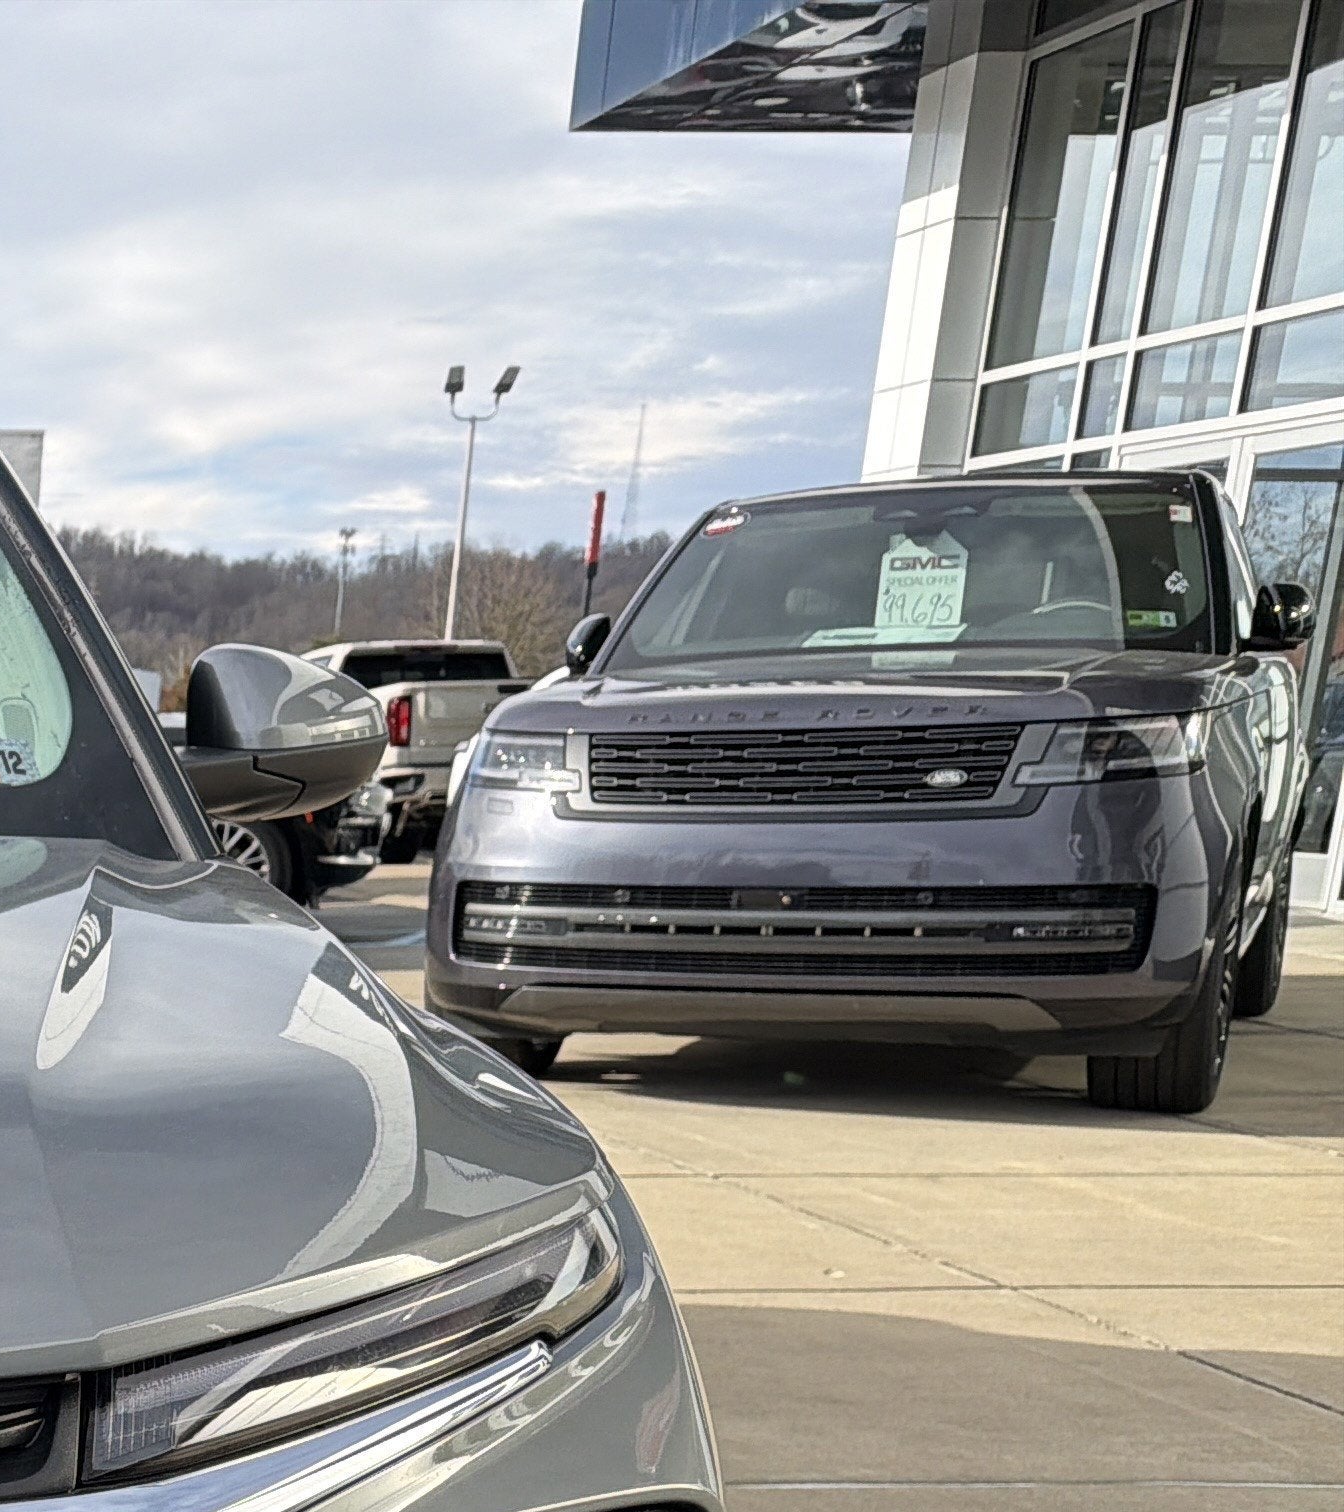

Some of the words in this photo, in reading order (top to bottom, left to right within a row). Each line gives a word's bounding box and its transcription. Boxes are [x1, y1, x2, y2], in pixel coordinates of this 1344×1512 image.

[891, 555, 960, 571] GMC
[887, 575, 923, 586] SPECIAL
[926, 574, 959, 585] OFFER
